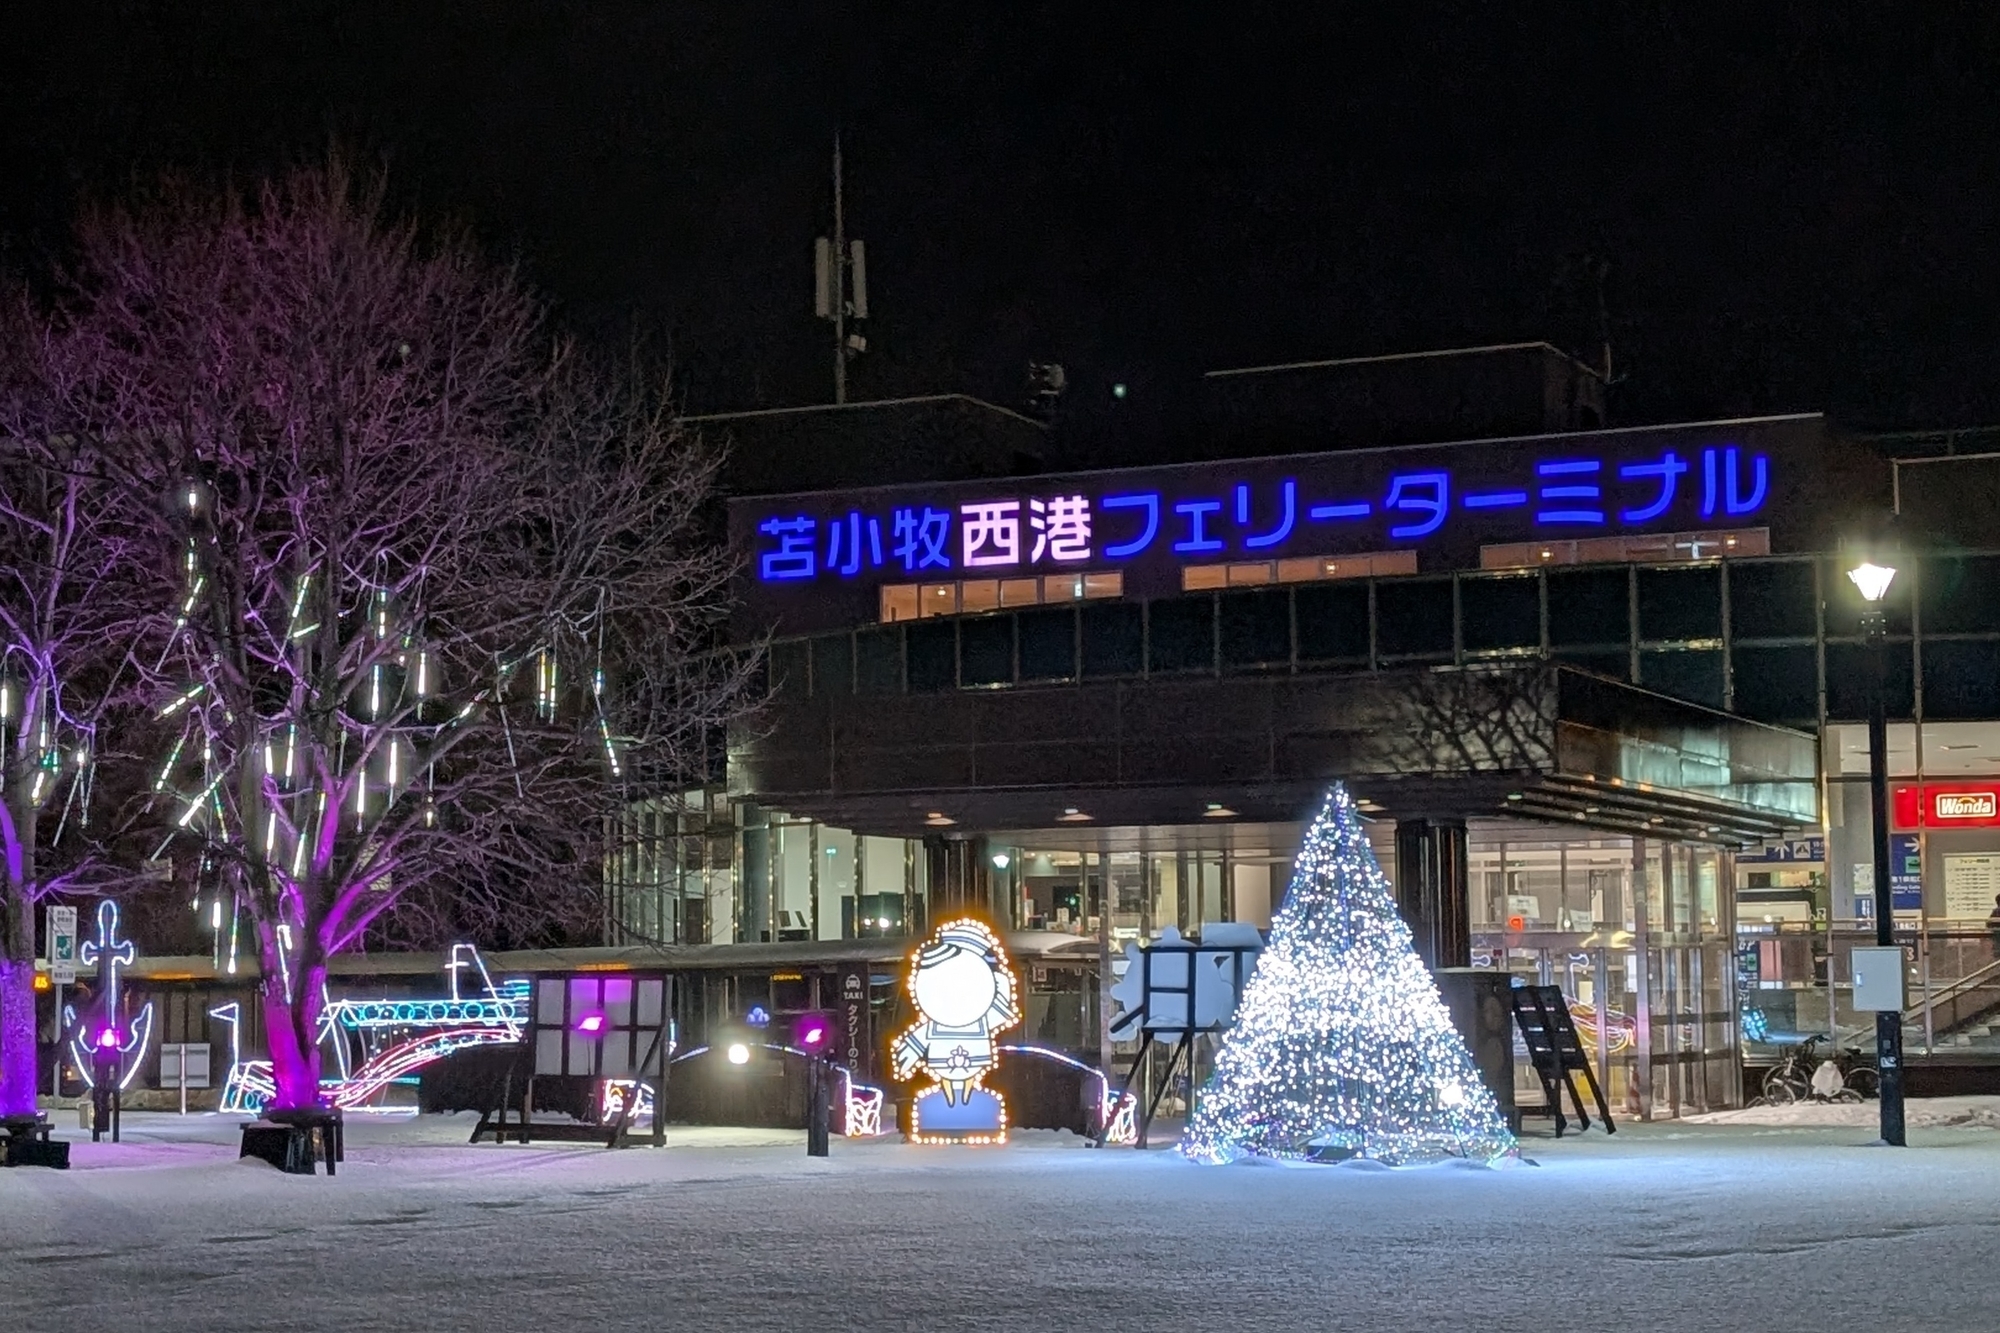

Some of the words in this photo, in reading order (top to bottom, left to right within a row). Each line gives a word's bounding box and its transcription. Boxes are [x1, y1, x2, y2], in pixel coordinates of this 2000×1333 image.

[760, 449, 1767, 580] 苫小牧西港フェリーターミナル
[1941, 798, 1991, 814] Wonda
[843, 991, 863, 999] TAXI
[848, 1004, 859, 1074] タクシーのり
